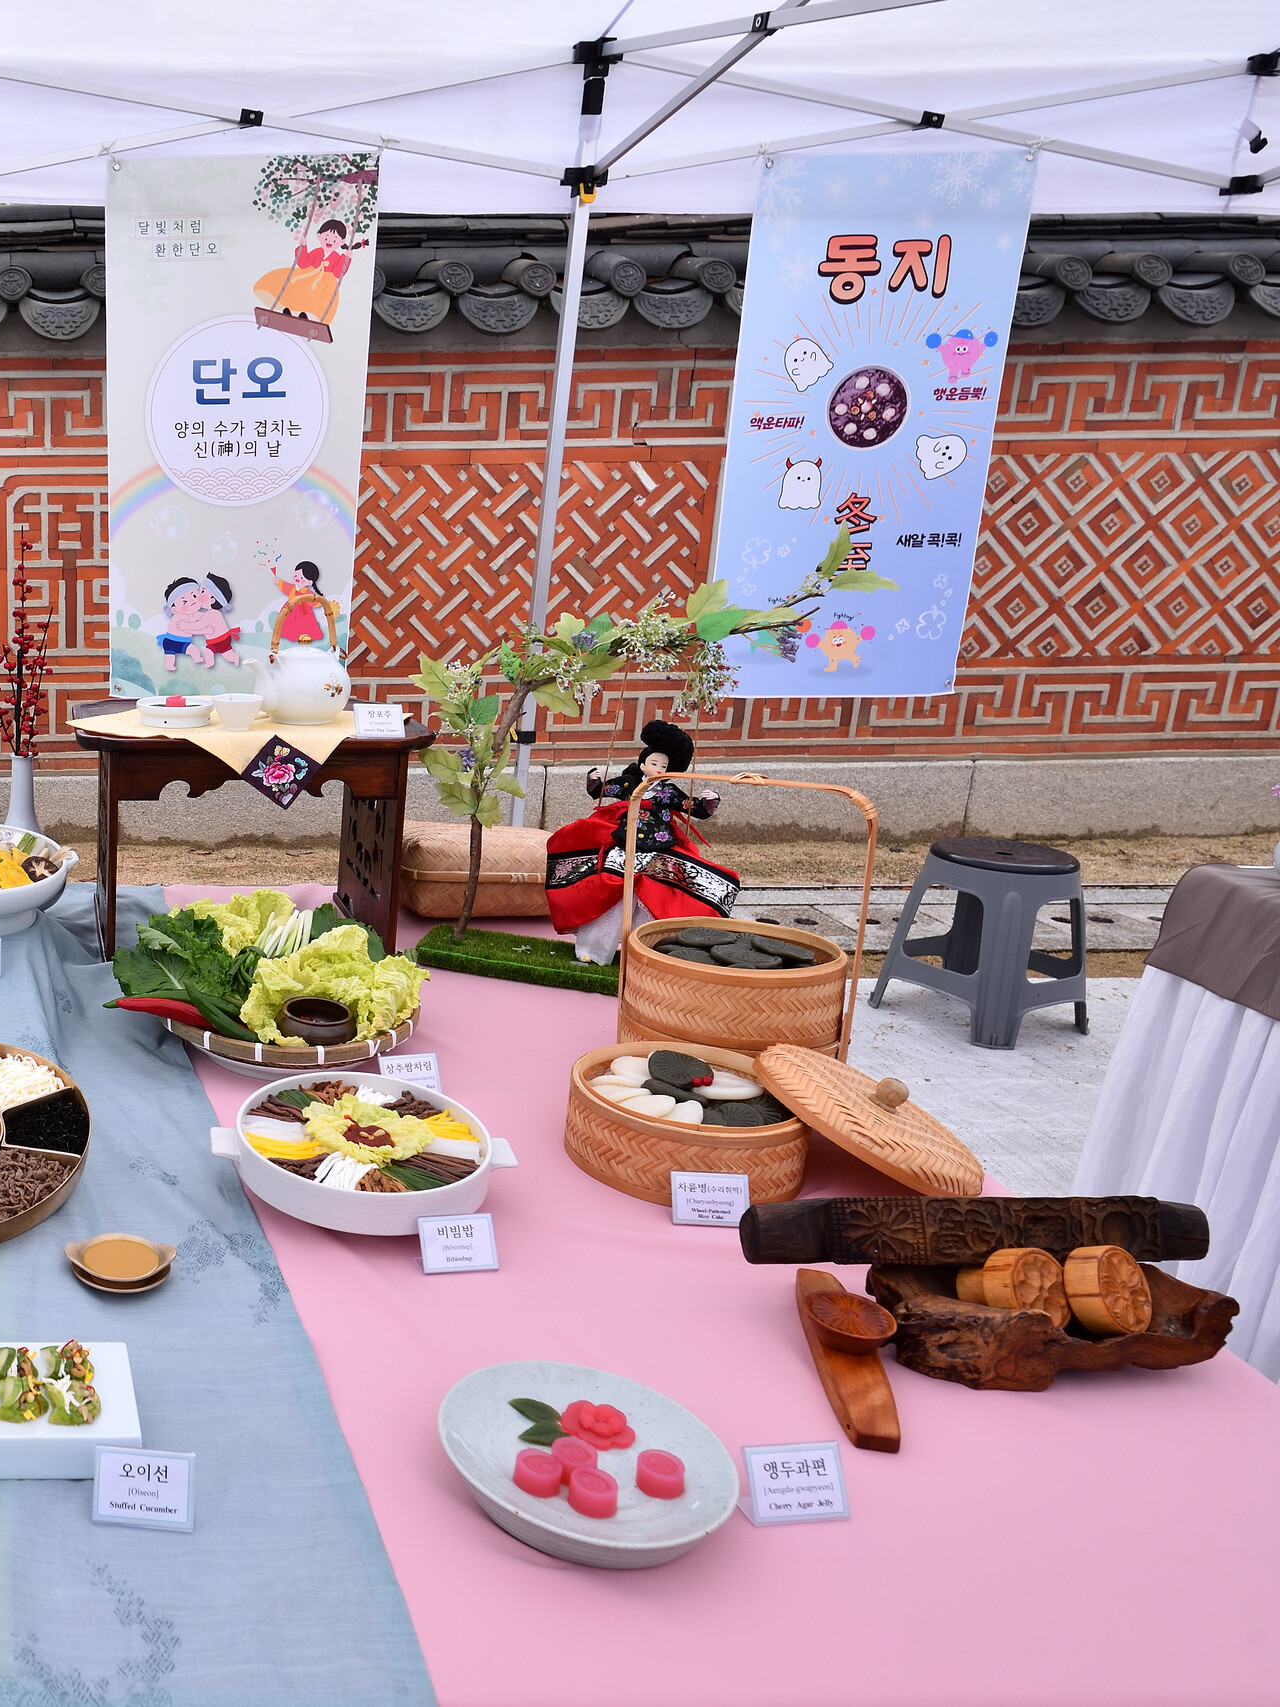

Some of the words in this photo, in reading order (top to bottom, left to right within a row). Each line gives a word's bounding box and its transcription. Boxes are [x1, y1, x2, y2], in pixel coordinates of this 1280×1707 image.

[819, 234, 952, 304] 동지
[193, 356, 286, 406] 단오
[933, 387, 987, 401] 행운듬뿍!
[174, 421, 205, 438] 양의
[214, 421, 245, 437] 수가
[254, 419, 302, 437] 겹치는
[750, 416, 805, 430] 액운타파!
[194, 440, 258, 459] 신(神)의
[267, 440, 282, 457] 날
[896, 534, 926, 548] 새알
[927, 533, 962, 547] 콕!콕!
[437, 1224, 474, 1239] 비빔밥
[119, 1463, 168, 1484] 오이선
[764, 1458, 827, 1480] 앵두과편
[128, 1487, 159, 1499] [Oiseon]
[110, 1501, 136, 1510] Stuffed
[140, 1504, 178, 1514] Cucumber
[769, 1503, 792, 1511] Cherry
[817, 1499, 834, 1508] Jelly
